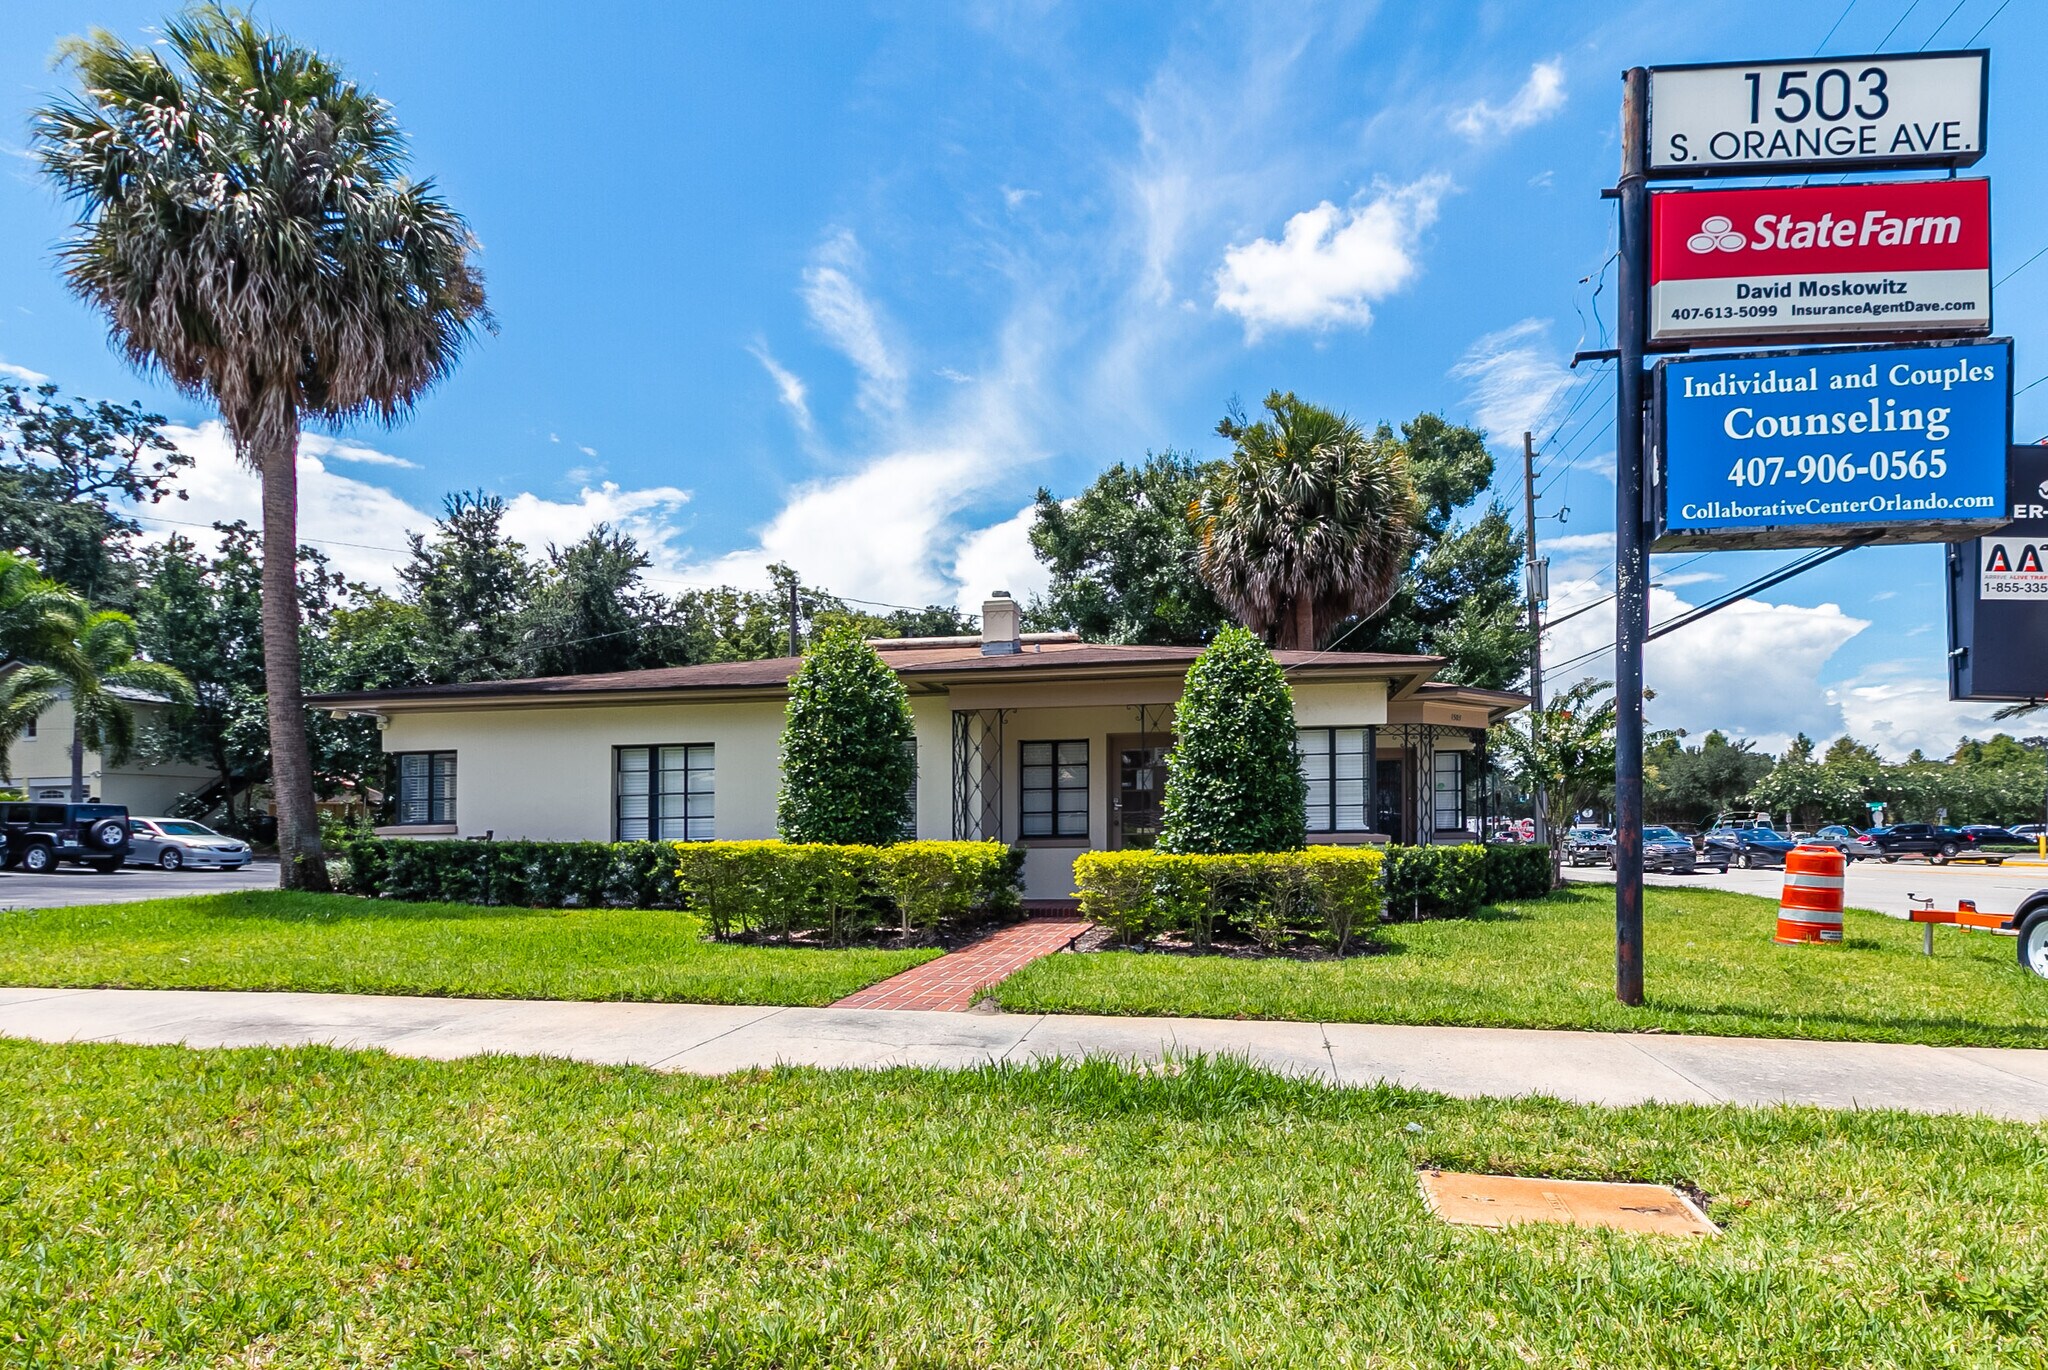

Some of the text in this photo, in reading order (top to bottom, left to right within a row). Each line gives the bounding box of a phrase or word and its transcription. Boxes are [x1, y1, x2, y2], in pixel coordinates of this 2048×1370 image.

[1744, 66, 1890, 125] 1503
[1670, 121, 1972, 163] S. ORANGE AVE.
[1736, 278, 1908, 300] David Moskowitz
[1671, 299, 1976, 321] 407-613-5099 InsuranceAgentDave.com
[1683, 359, 1995, 398] Individual and Couples
[1723, 398, 1951, 440] Counseling
[1727, 448, 1948, 487] 407-906-0565
[1681, 492, 1995, 520] CollaborativeCenterOrlando.com
[1985, 543, 2048, 572] AA
